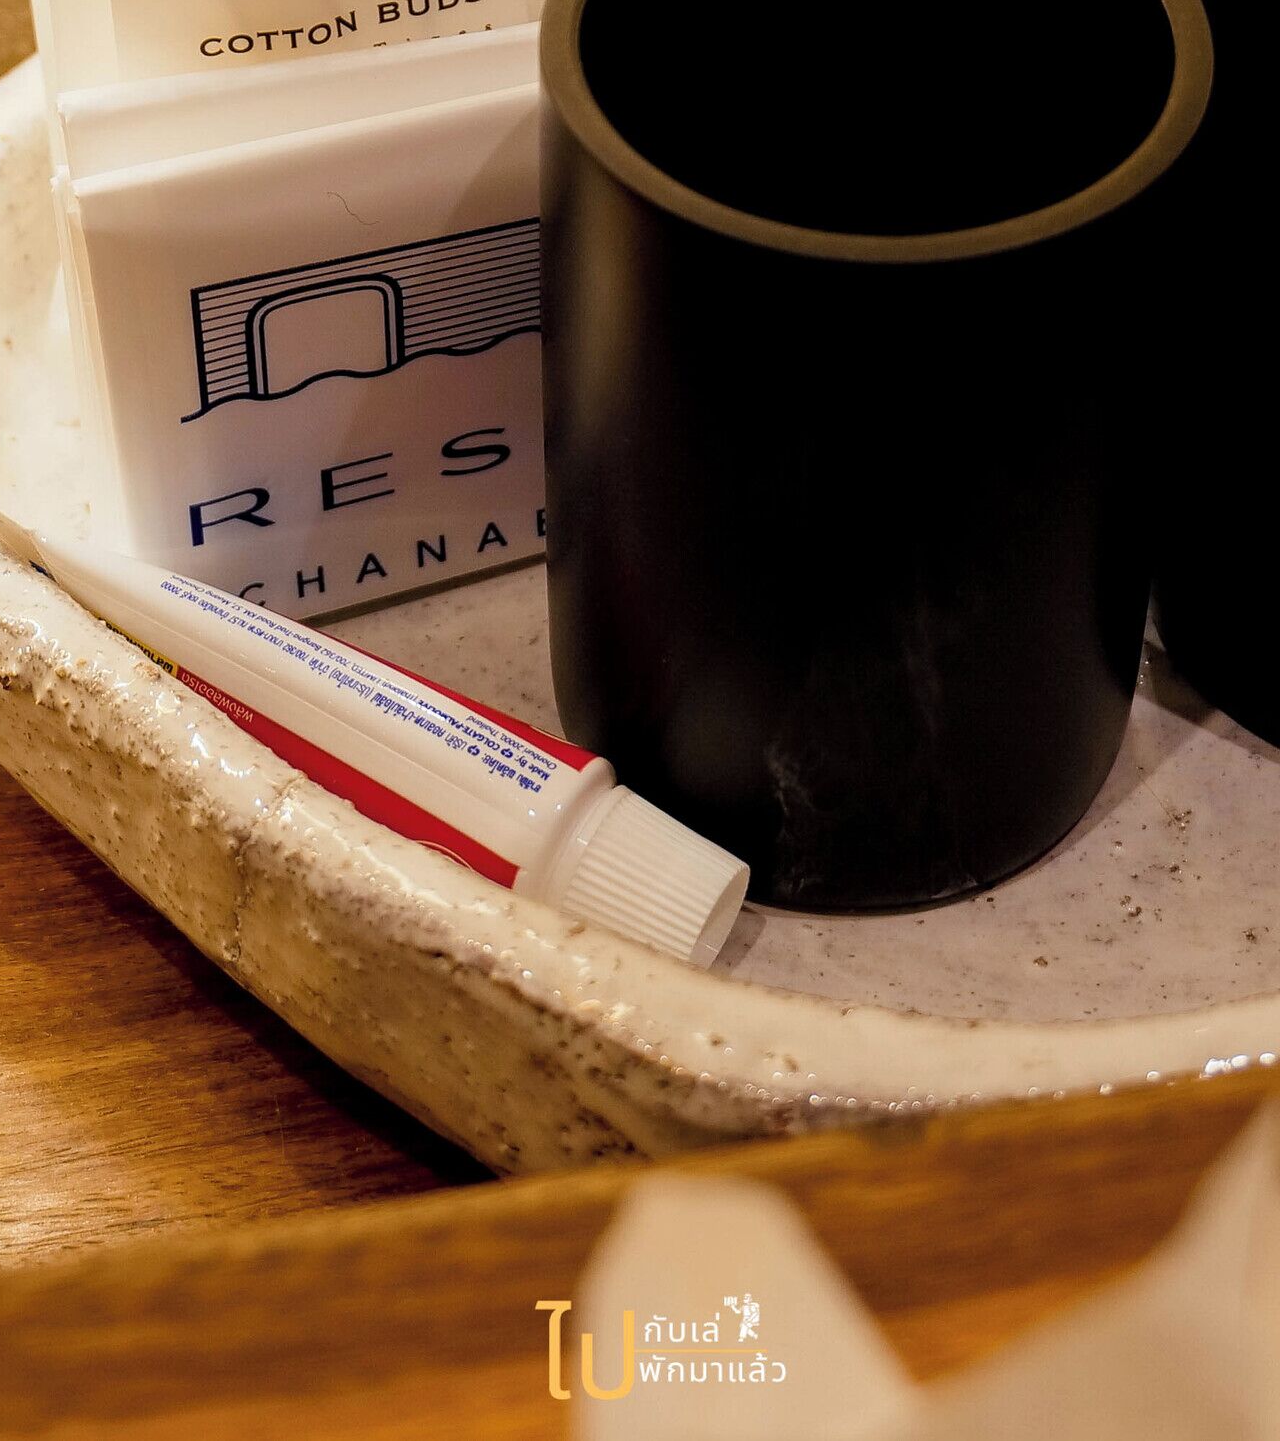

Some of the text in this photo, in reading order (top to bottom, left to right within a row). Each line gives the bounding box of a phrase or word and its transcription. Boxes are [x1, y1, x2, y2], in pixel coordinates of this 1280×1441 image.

[200, 11, 358, 57] COTTON
[465, 714, 501, 738] Thailand
[513, 754, 529, 769] By:
[521, 747, 558, 771] Chonburi
[527, 763, 552, 782] Made
